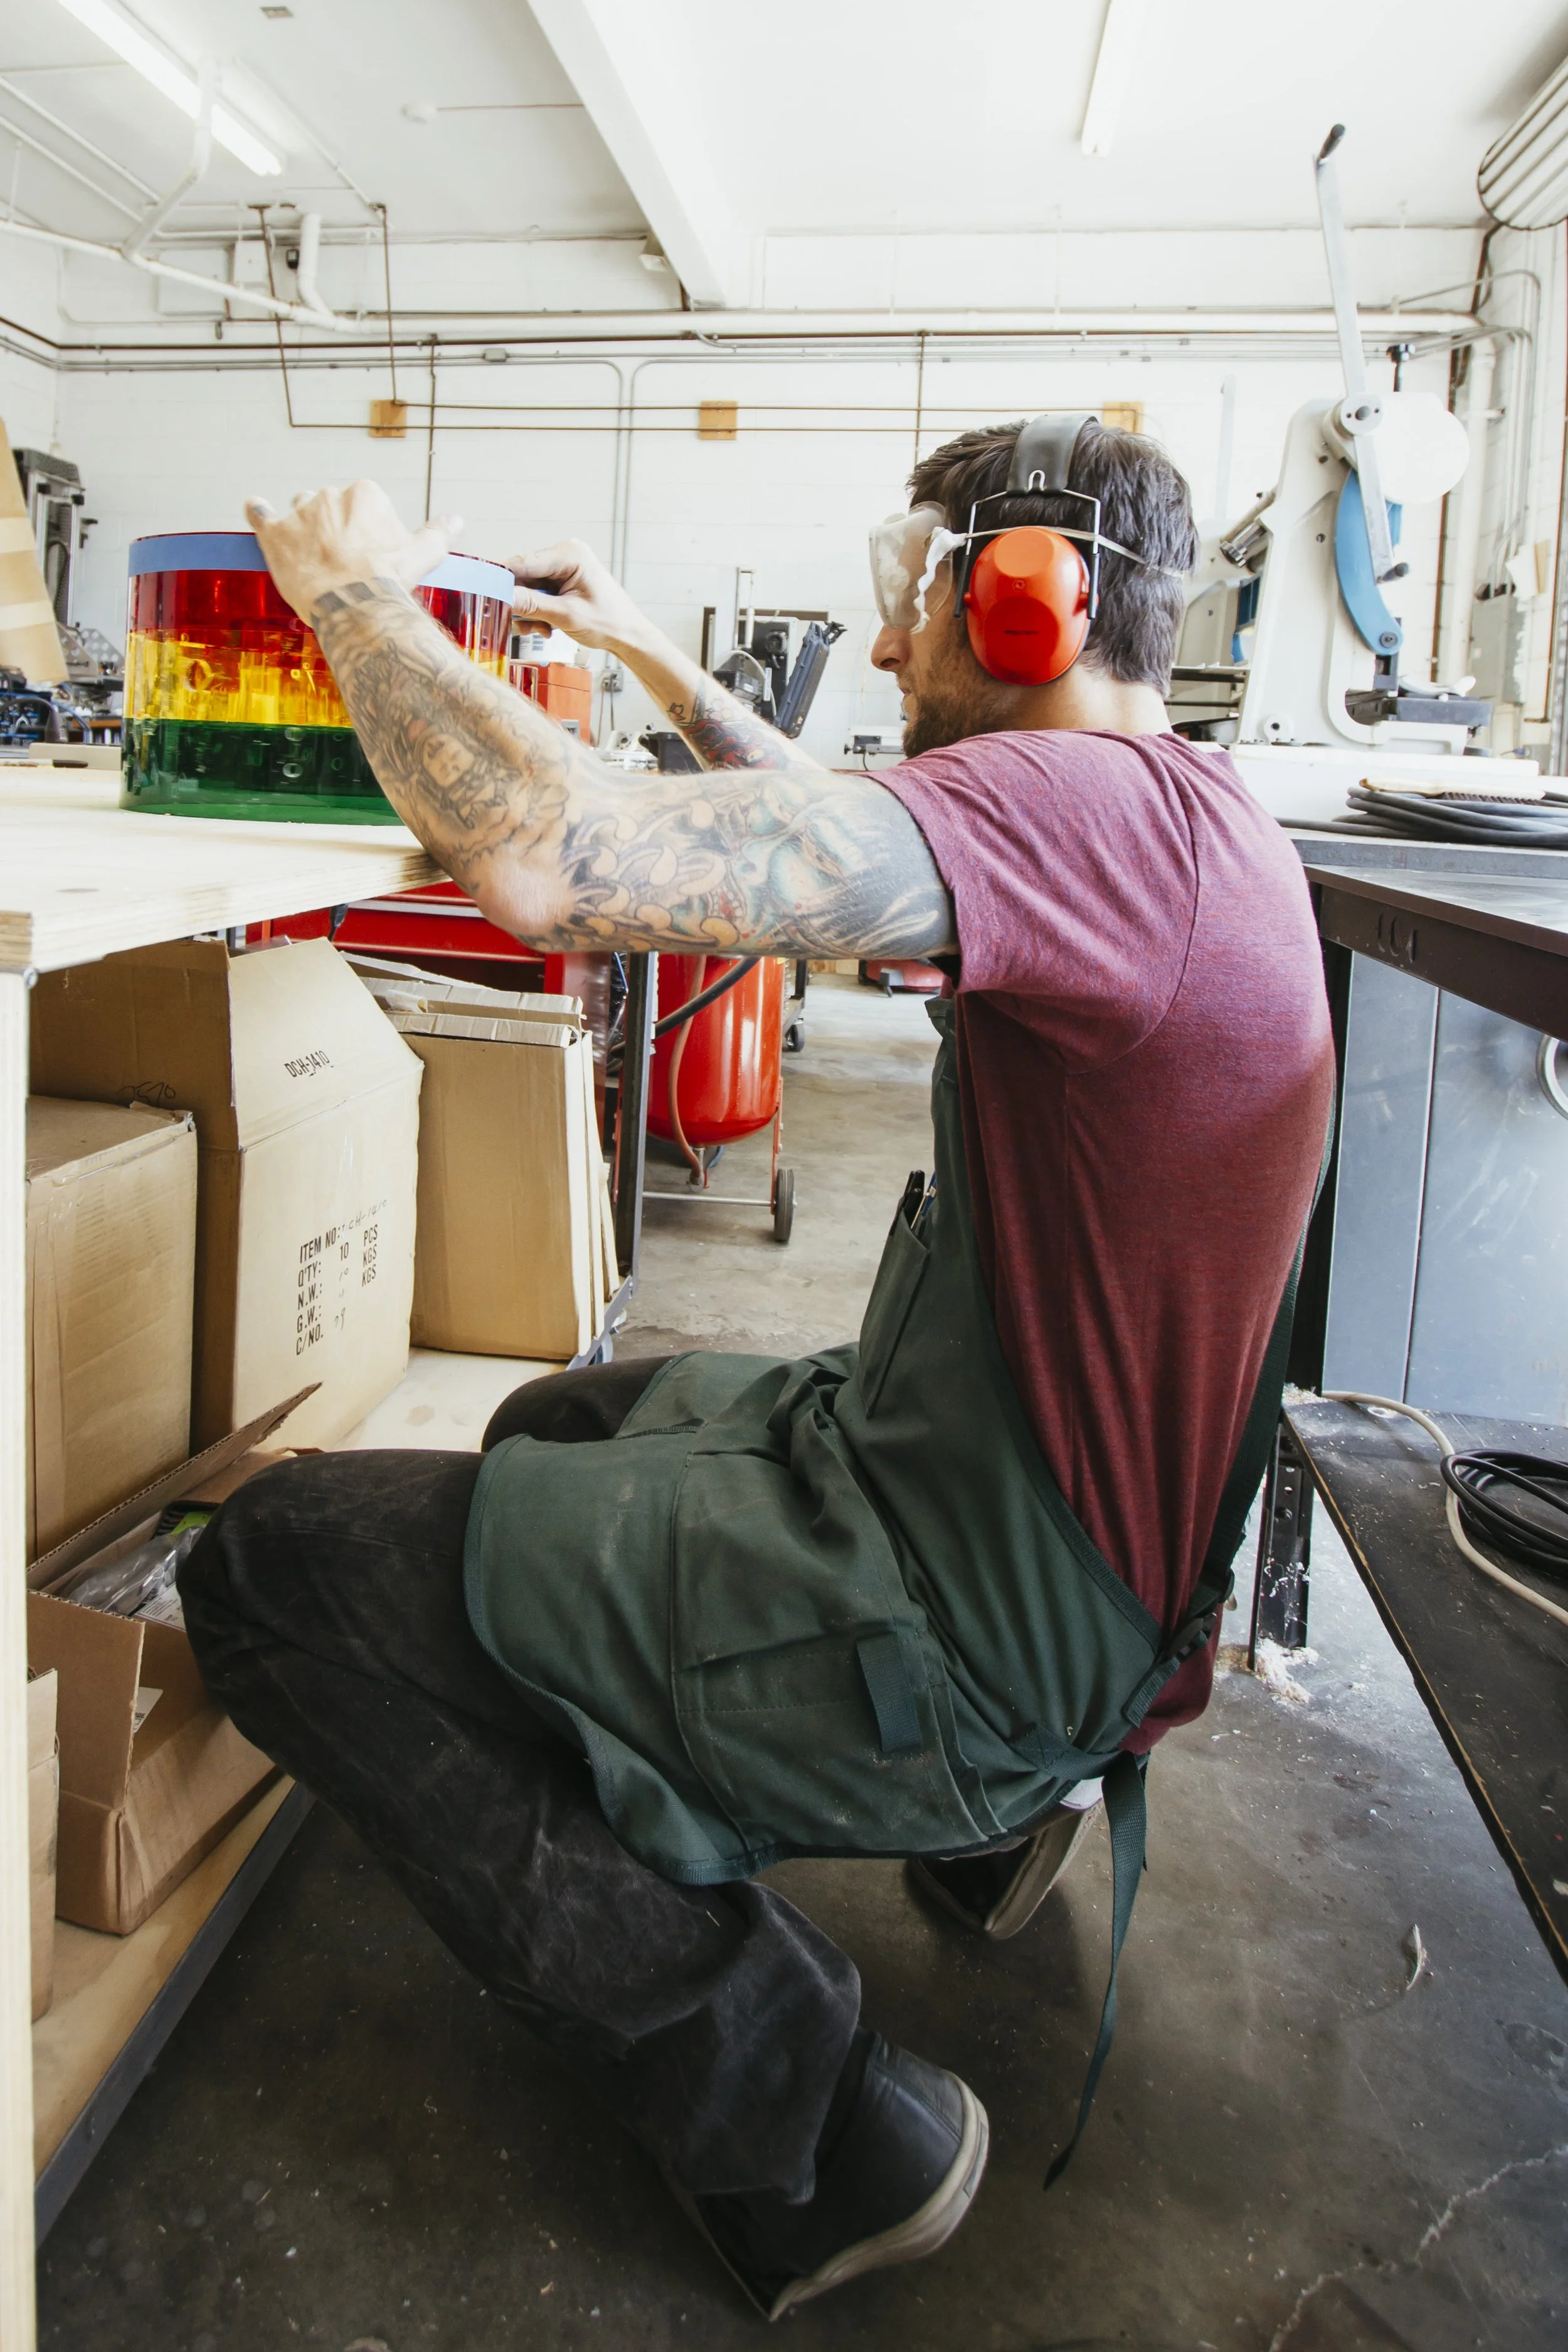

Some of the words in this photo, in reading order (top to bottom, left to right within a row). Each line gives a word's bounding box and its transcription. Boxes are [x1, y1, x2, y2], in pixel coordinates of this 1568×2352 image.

[283, 1050, 330, 1078] DCH-1410
[298, 1261, 321, 1287] Q'TY:
[340, 1242, 349, 1261] 10
[364, 1224, 378, 1247] PCS
[300, 1236, 322, 1264] ITEM
[325, 1226, 341, 1249] NO:
[297, 1283, 322, 1311] N.W.:
[363, 1244, 377, 1268] KGS
[297, 1305, 321, 1333] G.W.:
[361, 1263, 376, 1288] KGS
[296, 1323, 324, 1356] C/NO.
